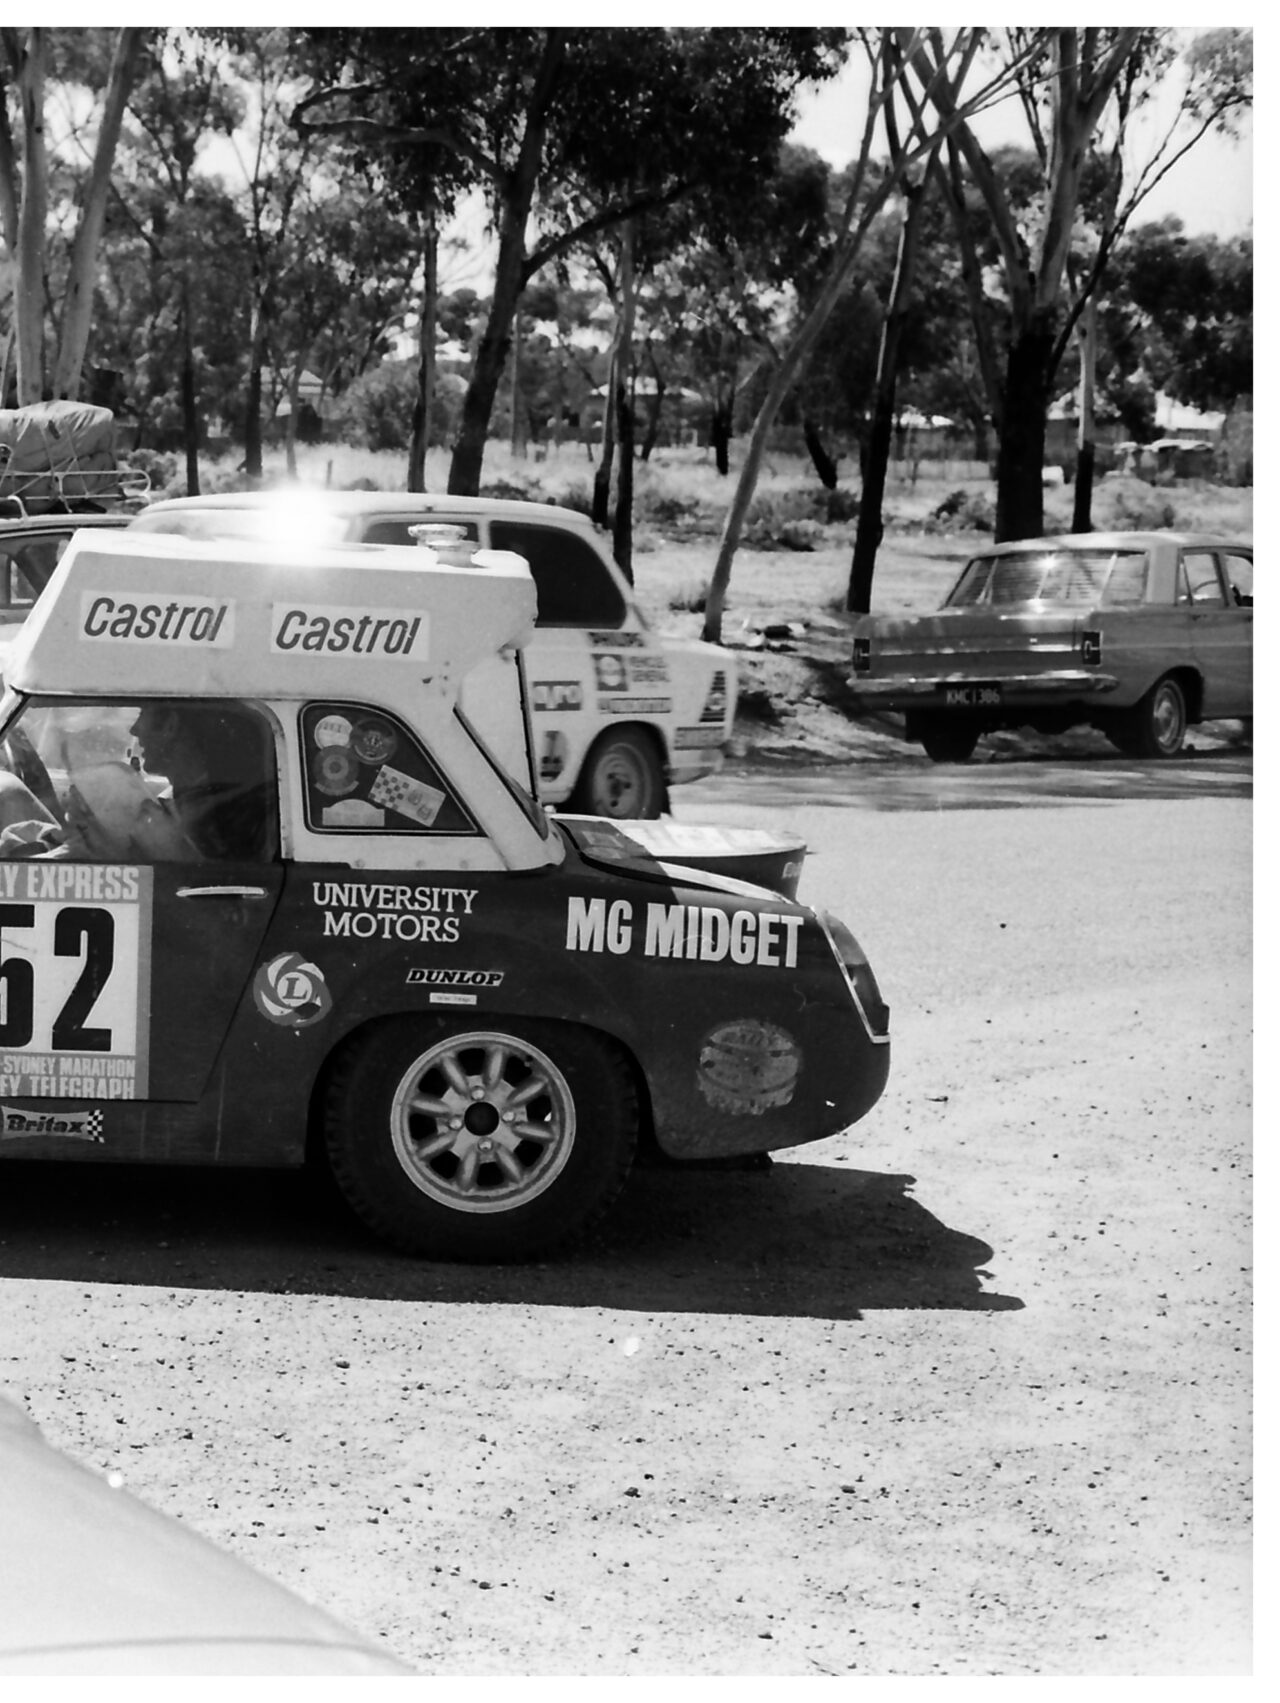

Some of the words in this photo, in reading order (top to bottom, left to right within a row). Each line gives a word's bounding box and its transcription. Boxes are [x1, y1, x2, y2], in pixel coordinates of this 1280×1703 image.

[83, 597, 228, 642] Castrol
[275, 610, 422, 655] Castrol
[27, 865, 140, 900] EXPRESS
[312, 881, 479, 915] UNIVERSITY
[322, 911, 461, 943] MOTORS
[565, 896, 633, 955] MG
[643, 902, 805, 968] MIDGET
[282, 977, 309, 1000] L
[407, 969, 503, 986] DUNLOP
[60, 1057, 136, 1078] MARATHON
[29, 1075, 136, 1100] TELEGRAPH
[6, 1113, 86, 1135] Britax
